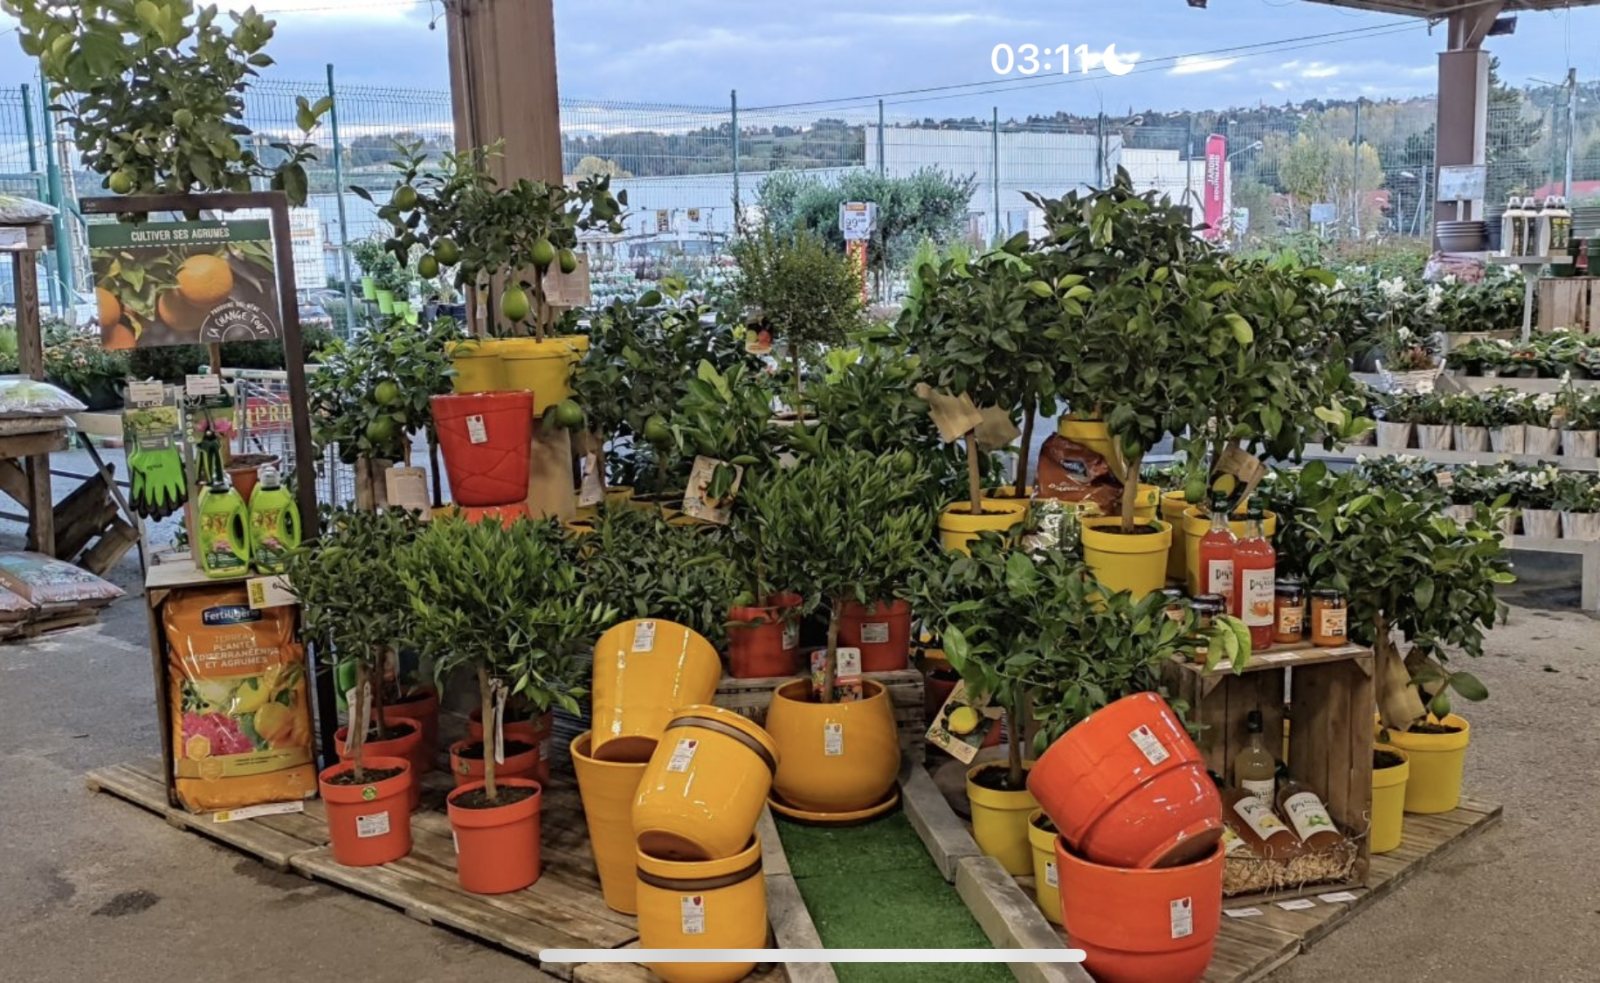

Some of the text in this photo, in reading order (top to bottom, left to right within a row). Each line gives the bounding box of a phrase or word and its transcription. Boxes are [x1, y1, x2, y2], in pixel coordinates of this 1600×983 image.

[131, 227, 231, 242] CULTIVER SES AGRUMES
[205, 661, 217, 669] ET
